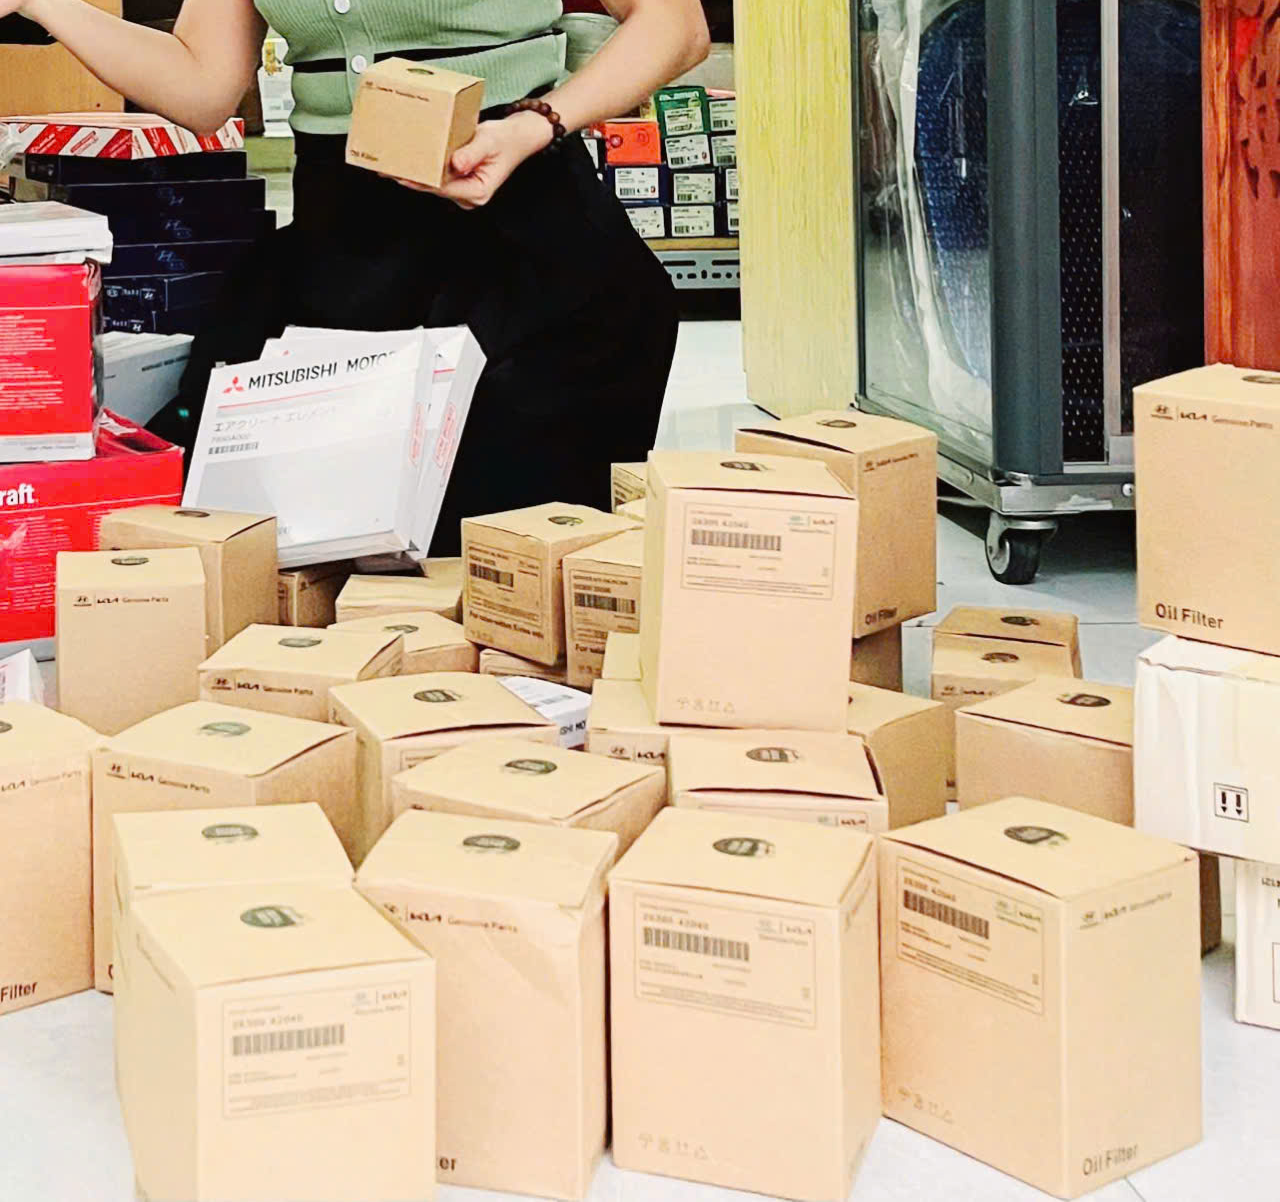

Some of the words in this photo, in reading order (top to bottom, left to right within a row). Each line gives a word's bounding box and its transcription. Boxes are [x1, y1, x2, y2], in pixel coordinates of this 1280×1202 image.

[248, 361, 338, 390] MITSUBISHI
[1249, 419, 1273, 430] Parts
[1155, 602, 1177, 621] Oil
[1181, 608, 1224, 630] Filter
[0, 981, 38, 1006] Filter
[1082, 1155, 1103, 1176] Oil
[1104, 1143, 1138, 1170] Filter
